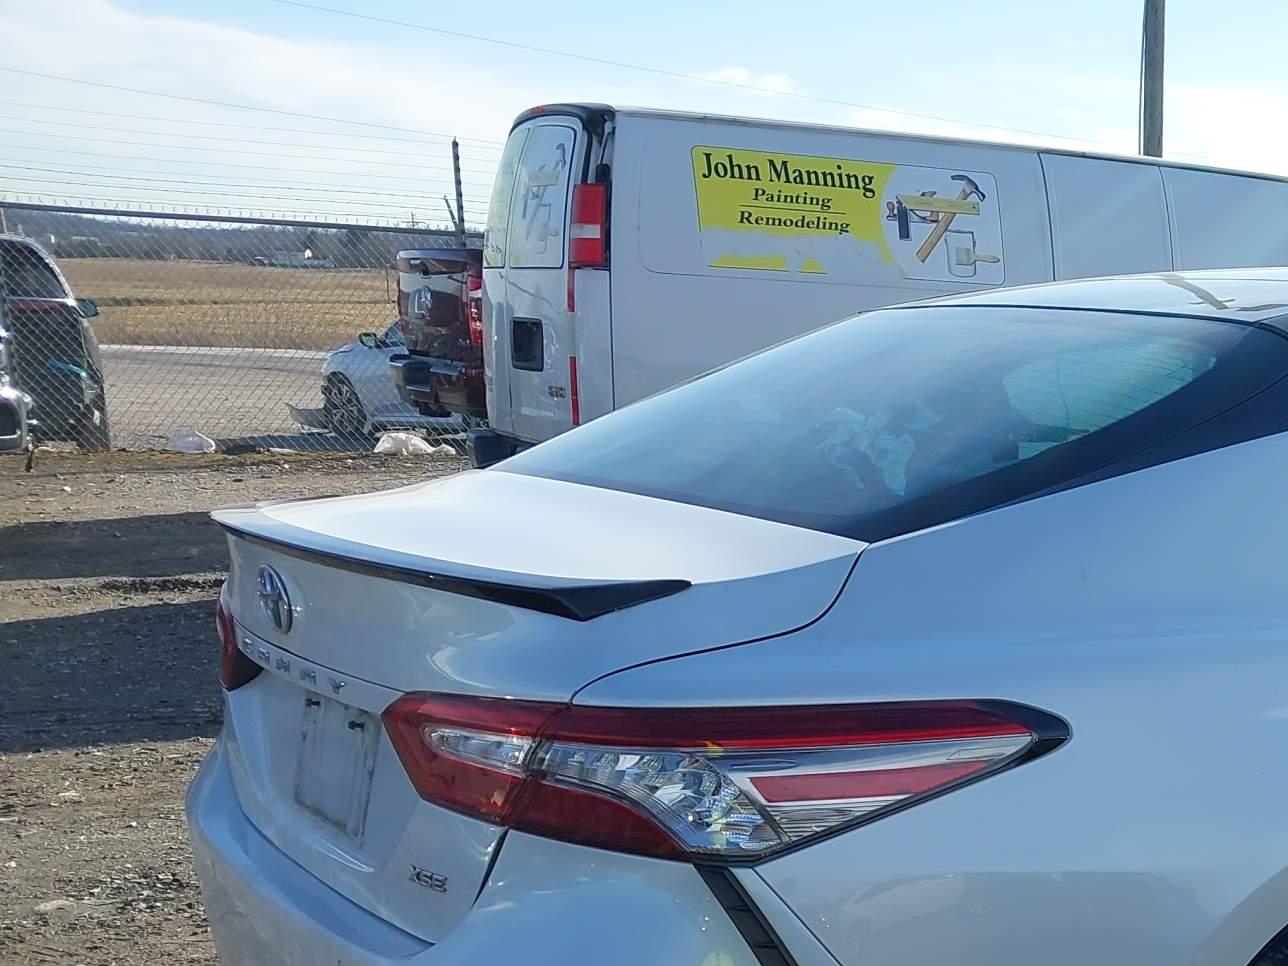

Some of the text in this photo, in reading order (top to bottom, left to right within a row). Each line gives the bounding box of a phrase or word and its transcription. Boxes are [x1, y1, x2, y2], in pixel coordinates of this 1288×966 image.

[701, 152, 876, 198] John Manning
[753, 187, 832, 210] Painting
[739, 211, 850, 234] Remodeling
[408, 864, 448, 893] XSE
